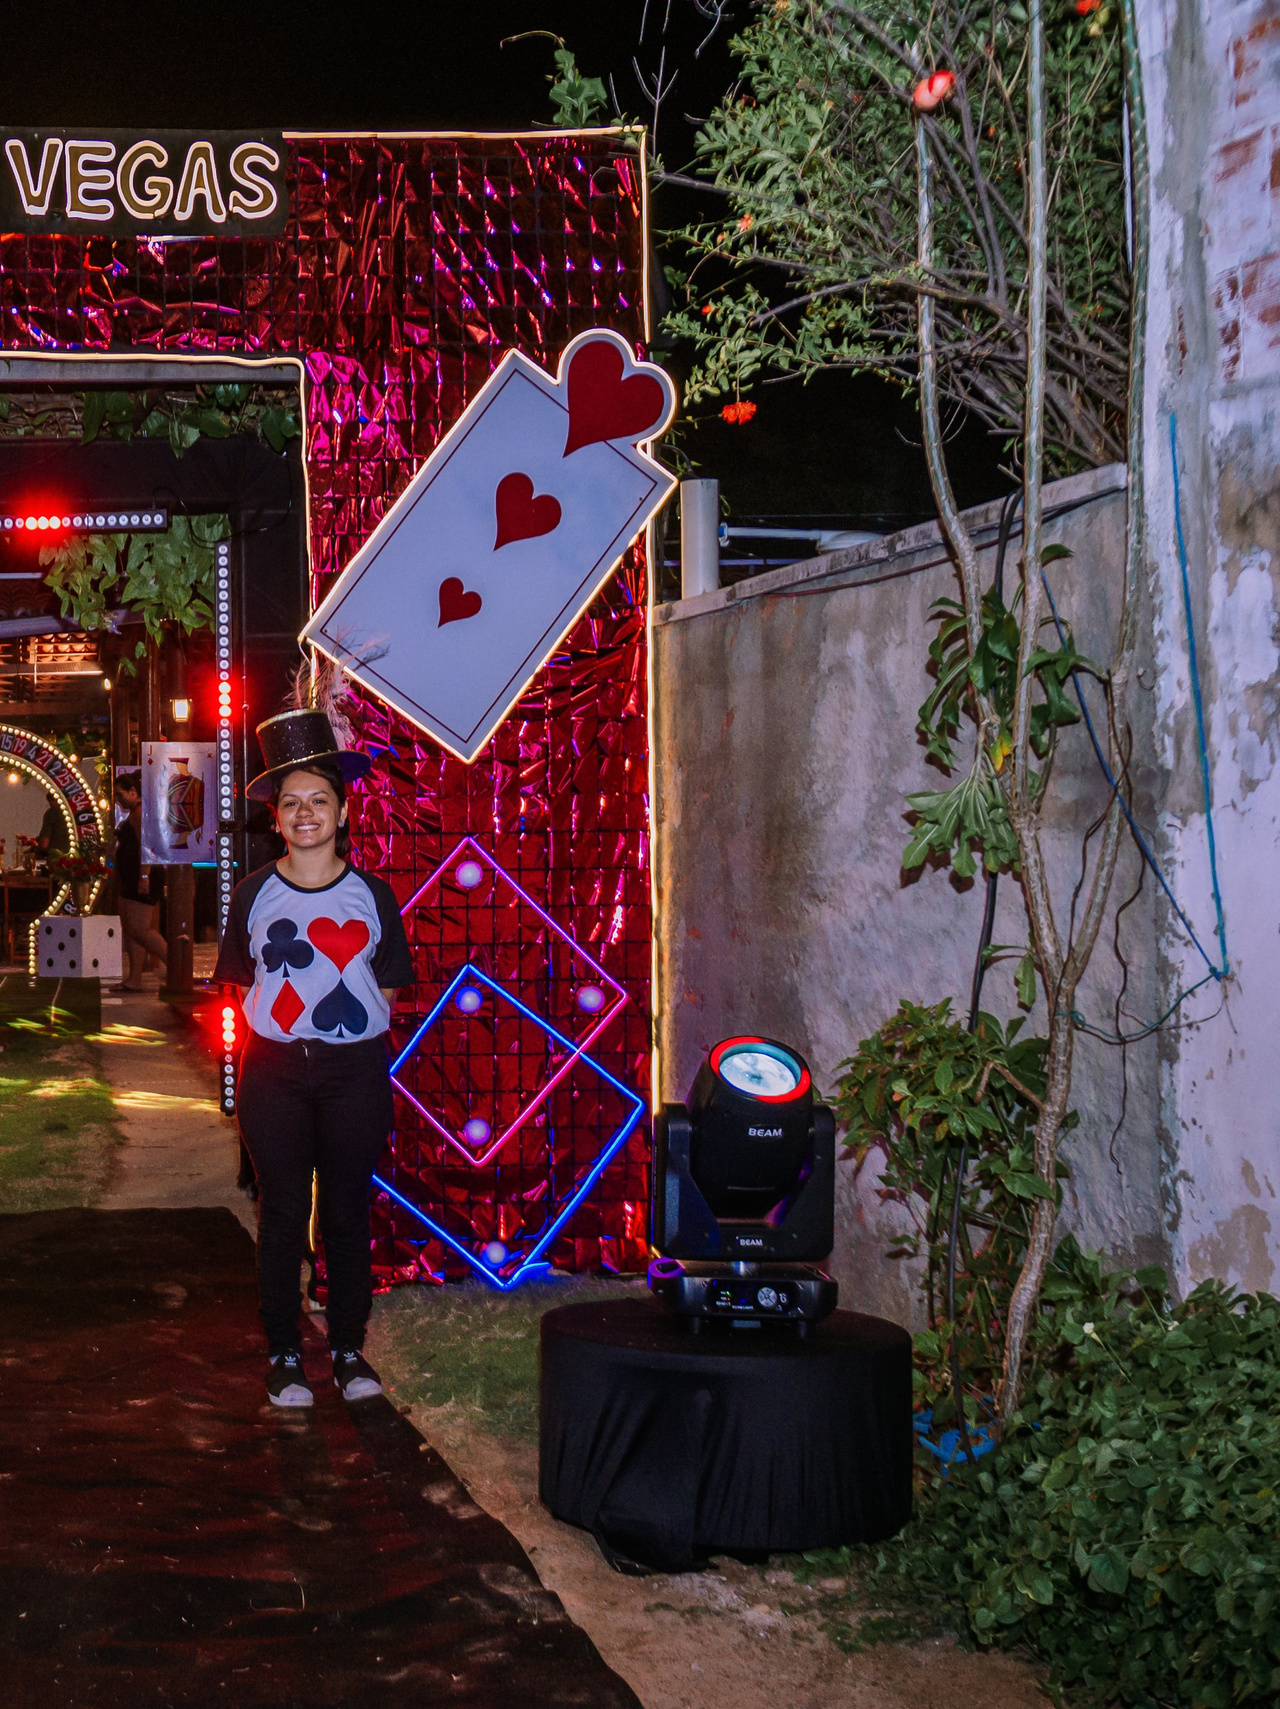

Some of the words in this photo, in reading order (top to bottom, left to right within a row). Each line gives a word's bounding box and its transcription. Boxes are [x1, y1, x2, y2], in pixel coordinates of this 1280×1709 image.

[5, 138, 280, 222] VEGAS
[1, 733, 13, 750] 15
[13, 739, 27, 753] 19
[27, 744, 38, 760] 4
[147, 744, 153, 757] J
[35, 750, 54, 768] 21
[48, 760, 62, 775] 2
[55, 768, 74, 787] 25
[65, 782, 82, 796] 17
[71, 792, 89, 811] 34
[78, 813, 94, 822] 6
[748, 1127, 783, 1137] BEAM
[739, 1238, 763, 1247] BEAM
